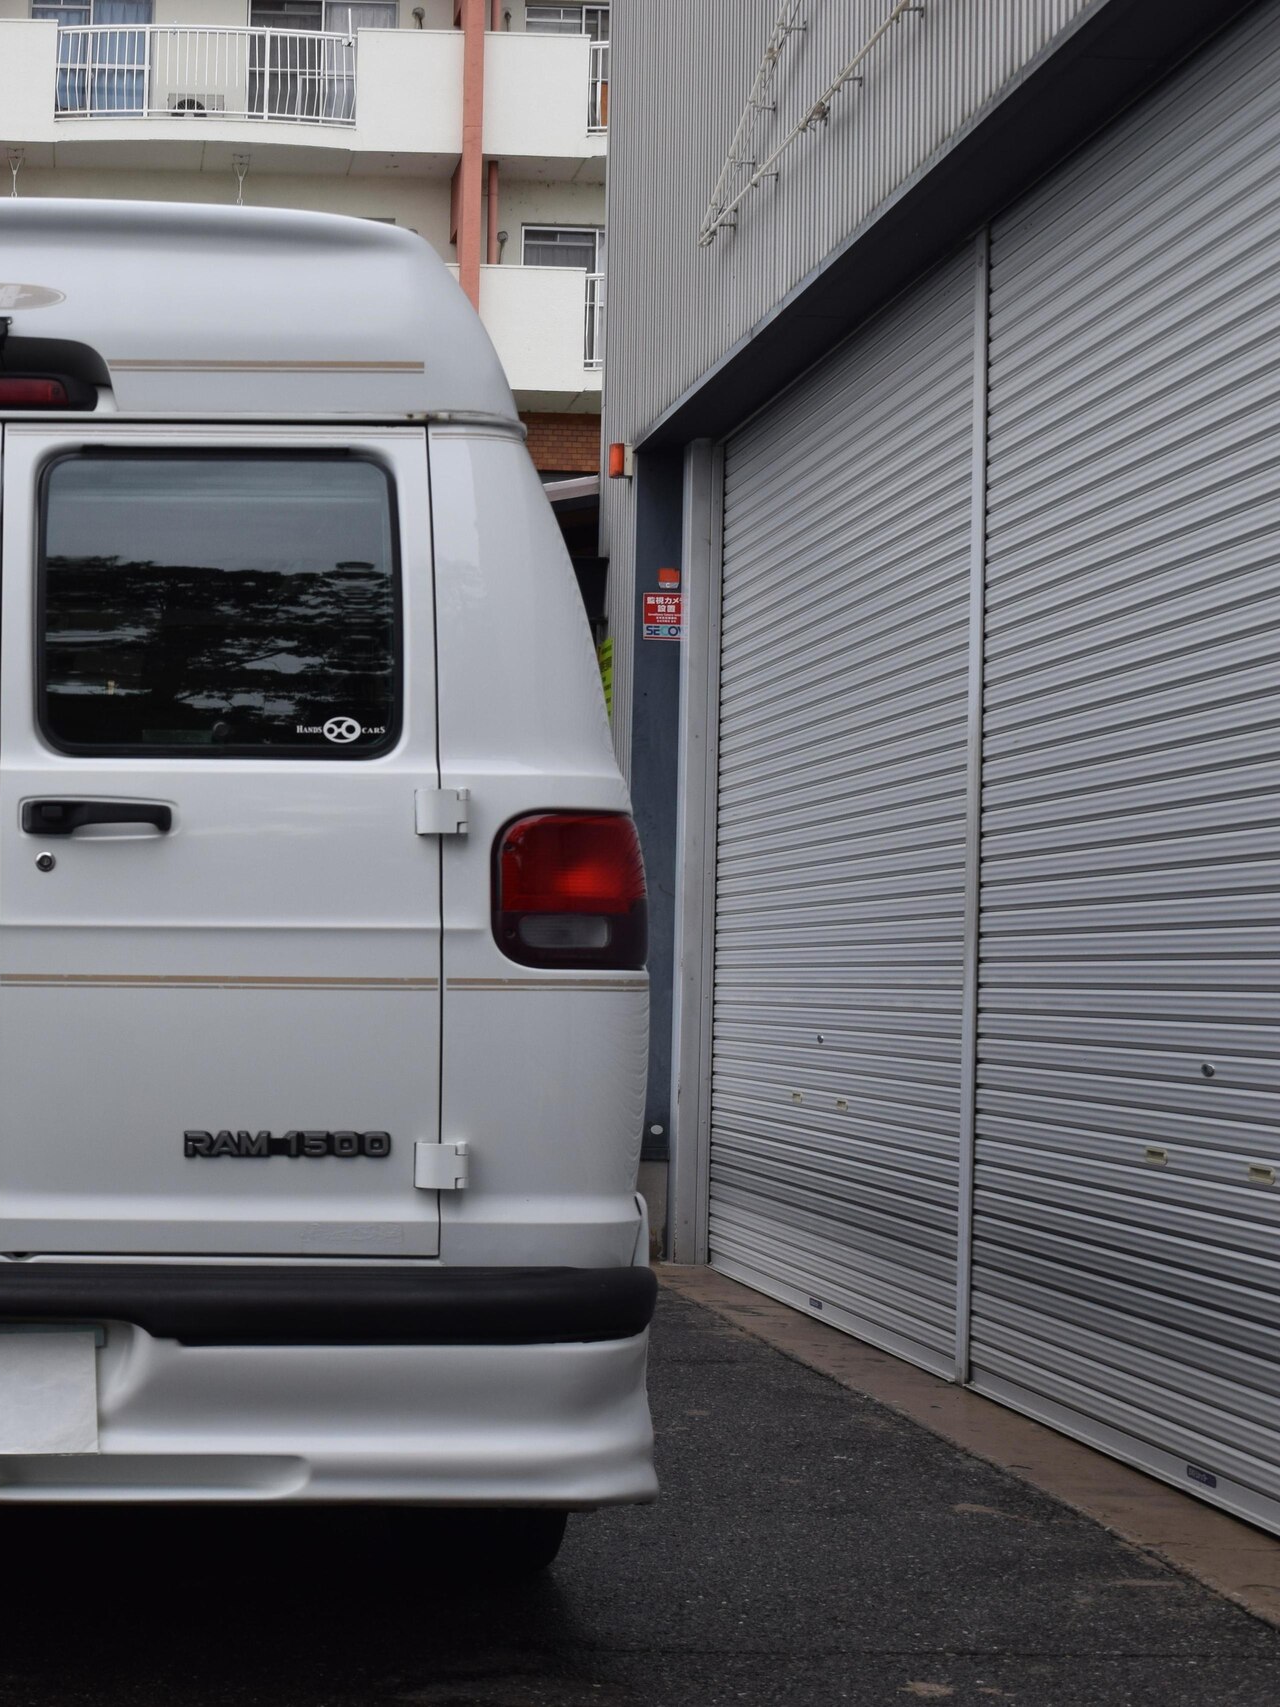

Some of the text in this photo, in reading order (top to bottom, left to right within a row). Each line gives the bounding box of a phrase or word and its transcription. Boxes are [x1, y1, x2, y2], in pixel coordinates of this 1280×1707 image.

[646, 596, 682, 604] 監視カメ
[646, 625, 681, 637] SECO
[184, 1130, 392, 1158] RAM 1500
